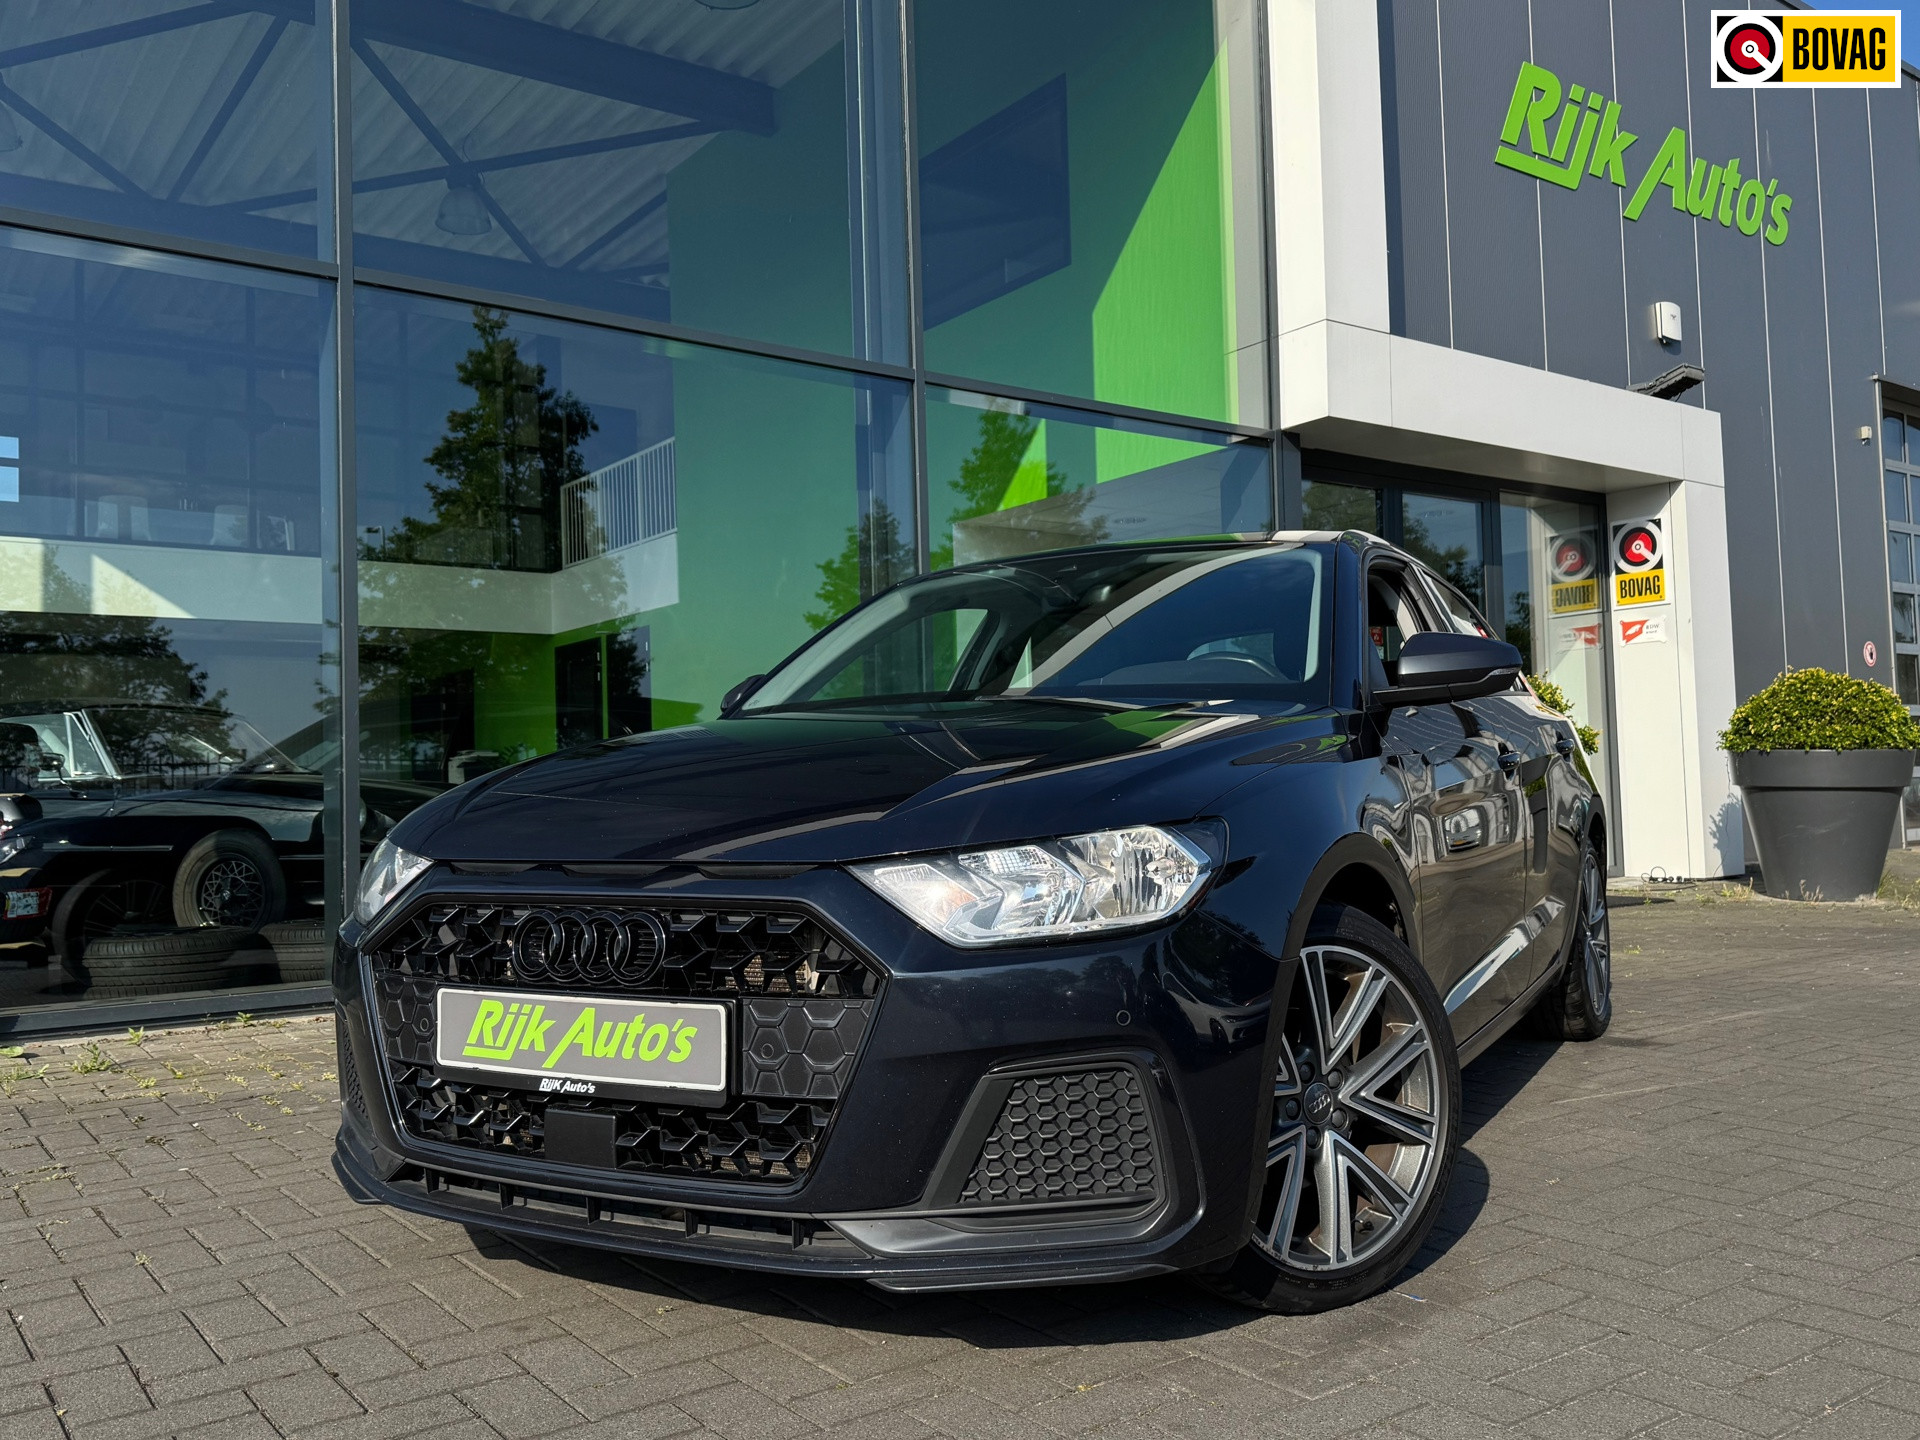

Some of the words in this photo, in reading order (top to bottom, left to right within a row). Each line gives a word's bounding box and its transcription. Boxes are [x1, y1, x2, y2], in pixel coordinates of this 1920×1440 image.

[1494, 61, 1638, 190] Rijk
[1623, 126, 1793, 246] Auto's
[1620, 575, 1661, 599] BOVAG
[462, 999, 556, 1061] Rijk
[541, 1007, 698, 1069] Auto's
[560, 1080, 596, 1094] Auto's
